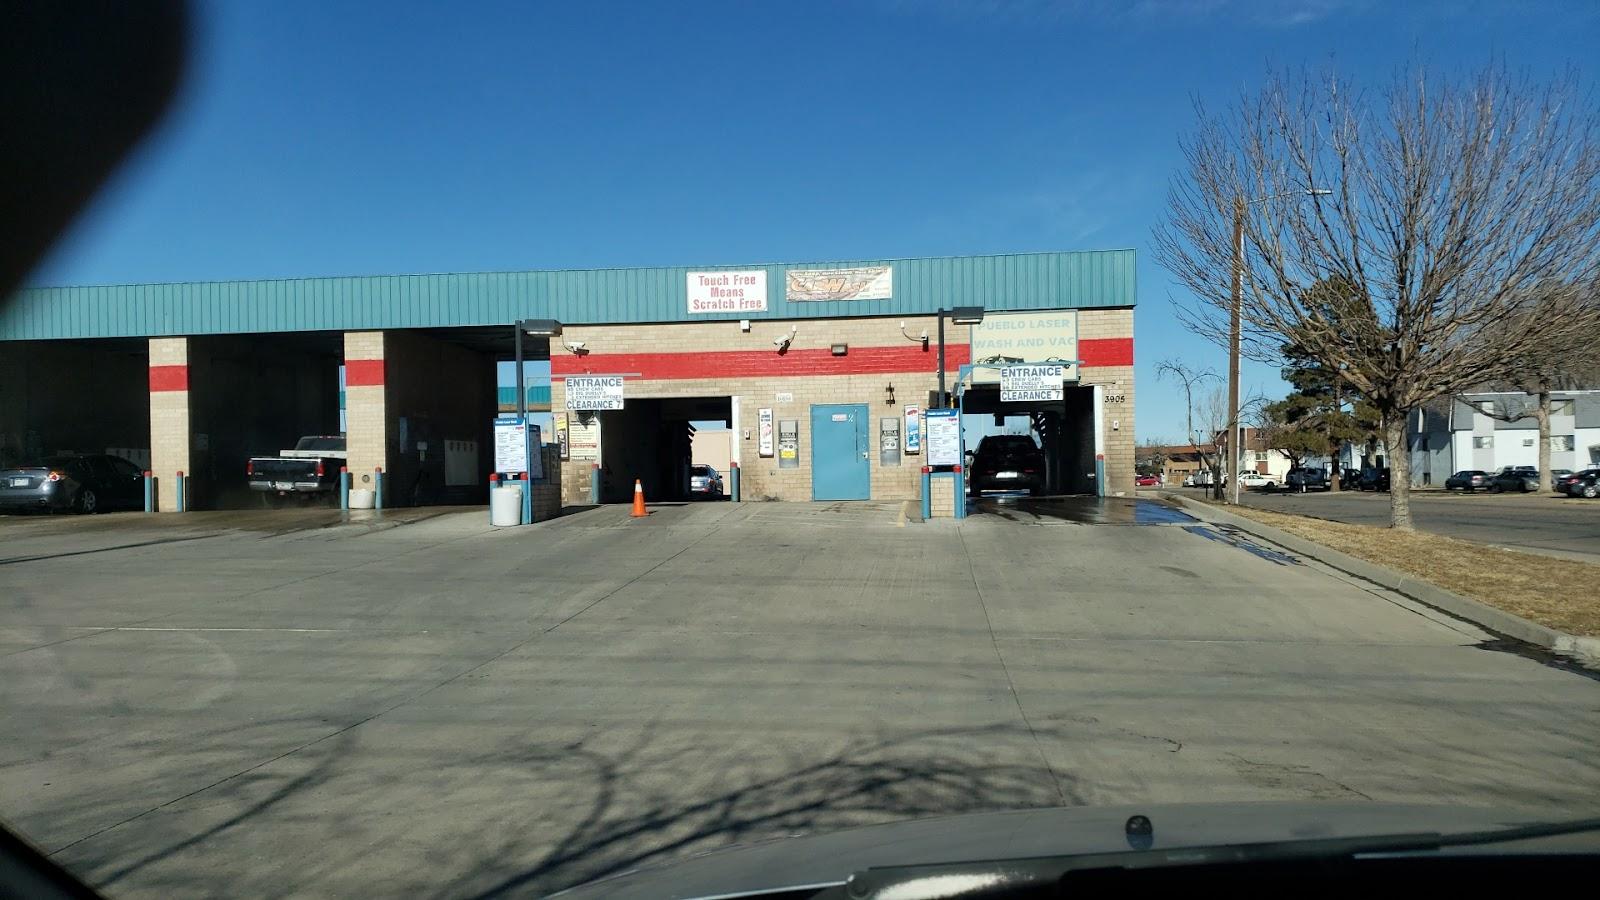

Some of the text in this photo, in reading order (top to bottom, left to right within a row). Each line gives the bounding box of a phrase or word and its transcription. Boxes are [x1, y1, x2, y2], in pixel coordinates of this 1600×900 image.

[698, 274, 756, 286] Touch Free
[710, 287, 744, 298] Means
[693, 298, 762, 310] Scratch Free
[978, 319, 1070, 330] PUEBLO LASER
[975, 337, 1075, 348] WASH AND VAC
[1001, 367, 1062, 377] ENTRANCE
[566, 378, 622, 387] ENTRANCE
[1001, 390, 1052, 401] CLEARANCE
[1104, 395, 1126, 403] 3905
[566, 400, 613, 409] CLEARANCE
